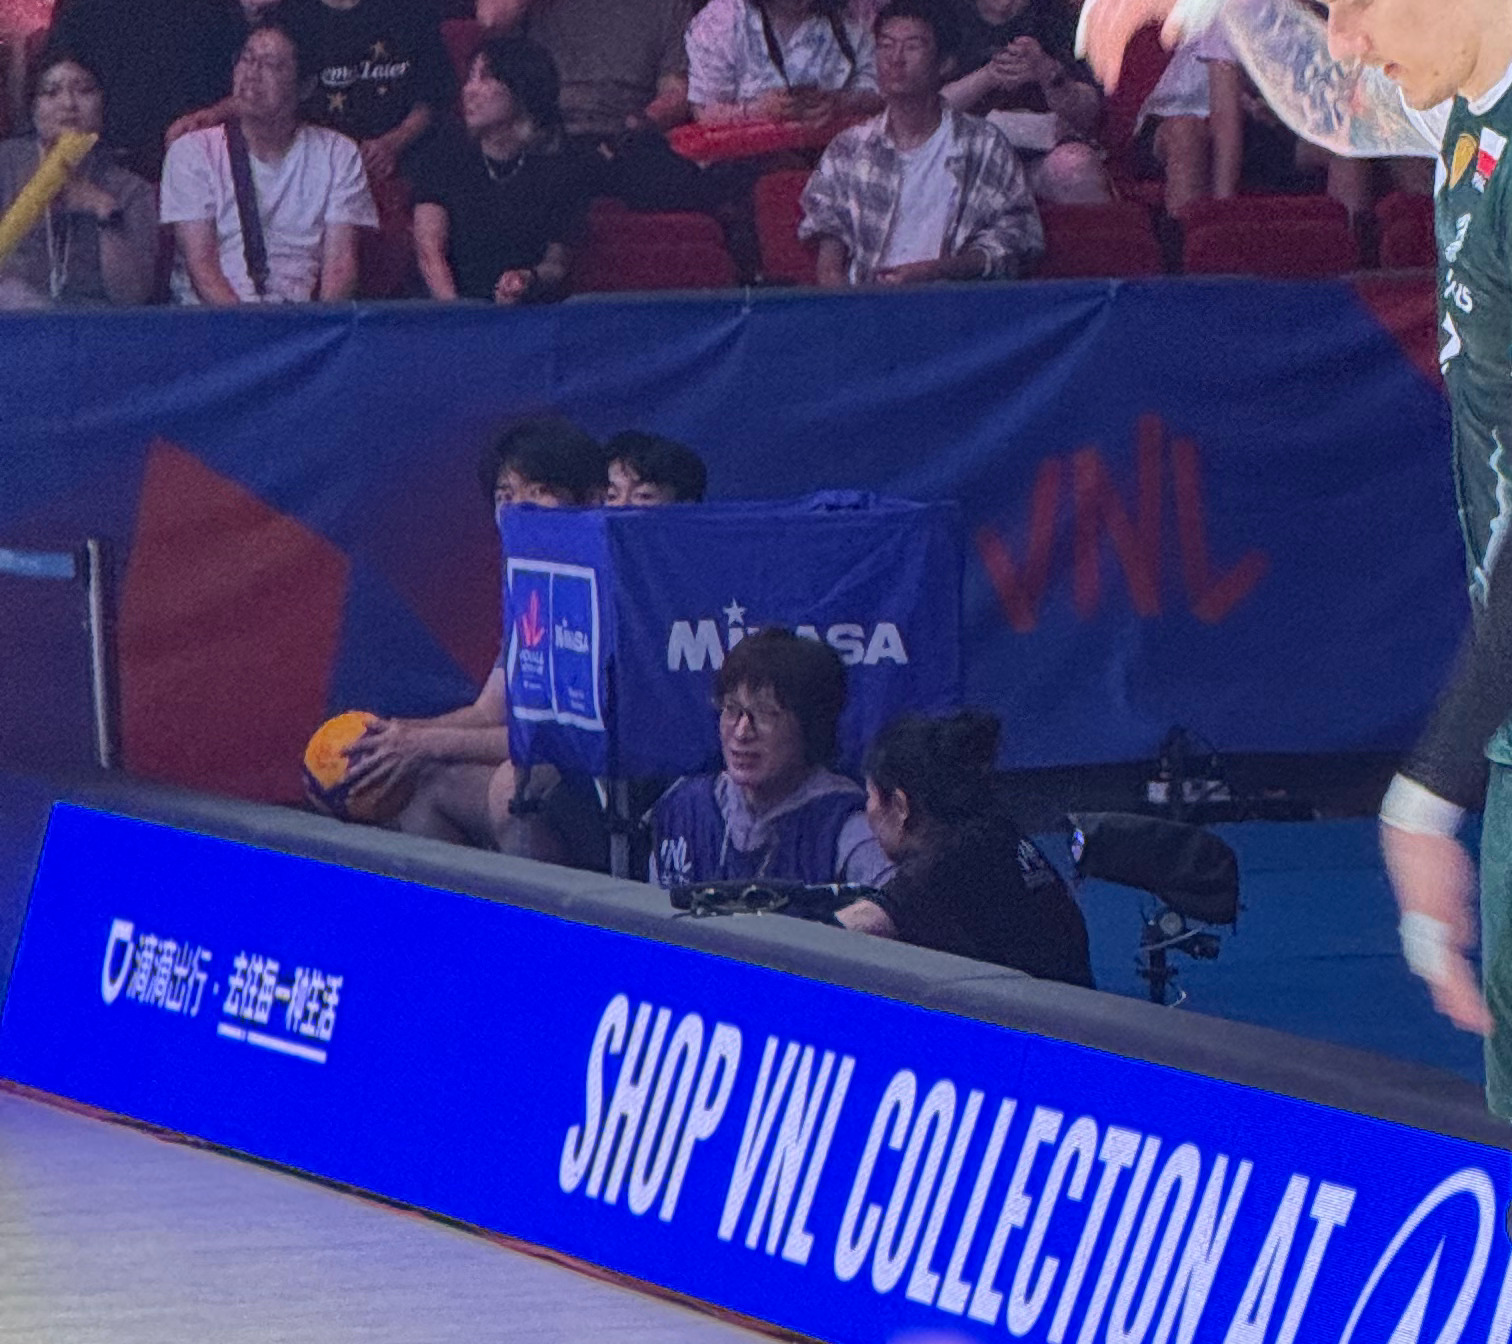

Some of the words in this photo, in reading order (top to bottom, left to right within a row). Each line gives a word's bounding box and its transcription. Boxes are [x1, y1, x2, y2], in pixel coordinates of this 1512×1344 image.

[974, 412, 1272, 634] VNL
[667, 597, 909, 672] MISA
[558, 993, 742, 1223] SHOP
[716, 1034, 856, 1266] VNL
